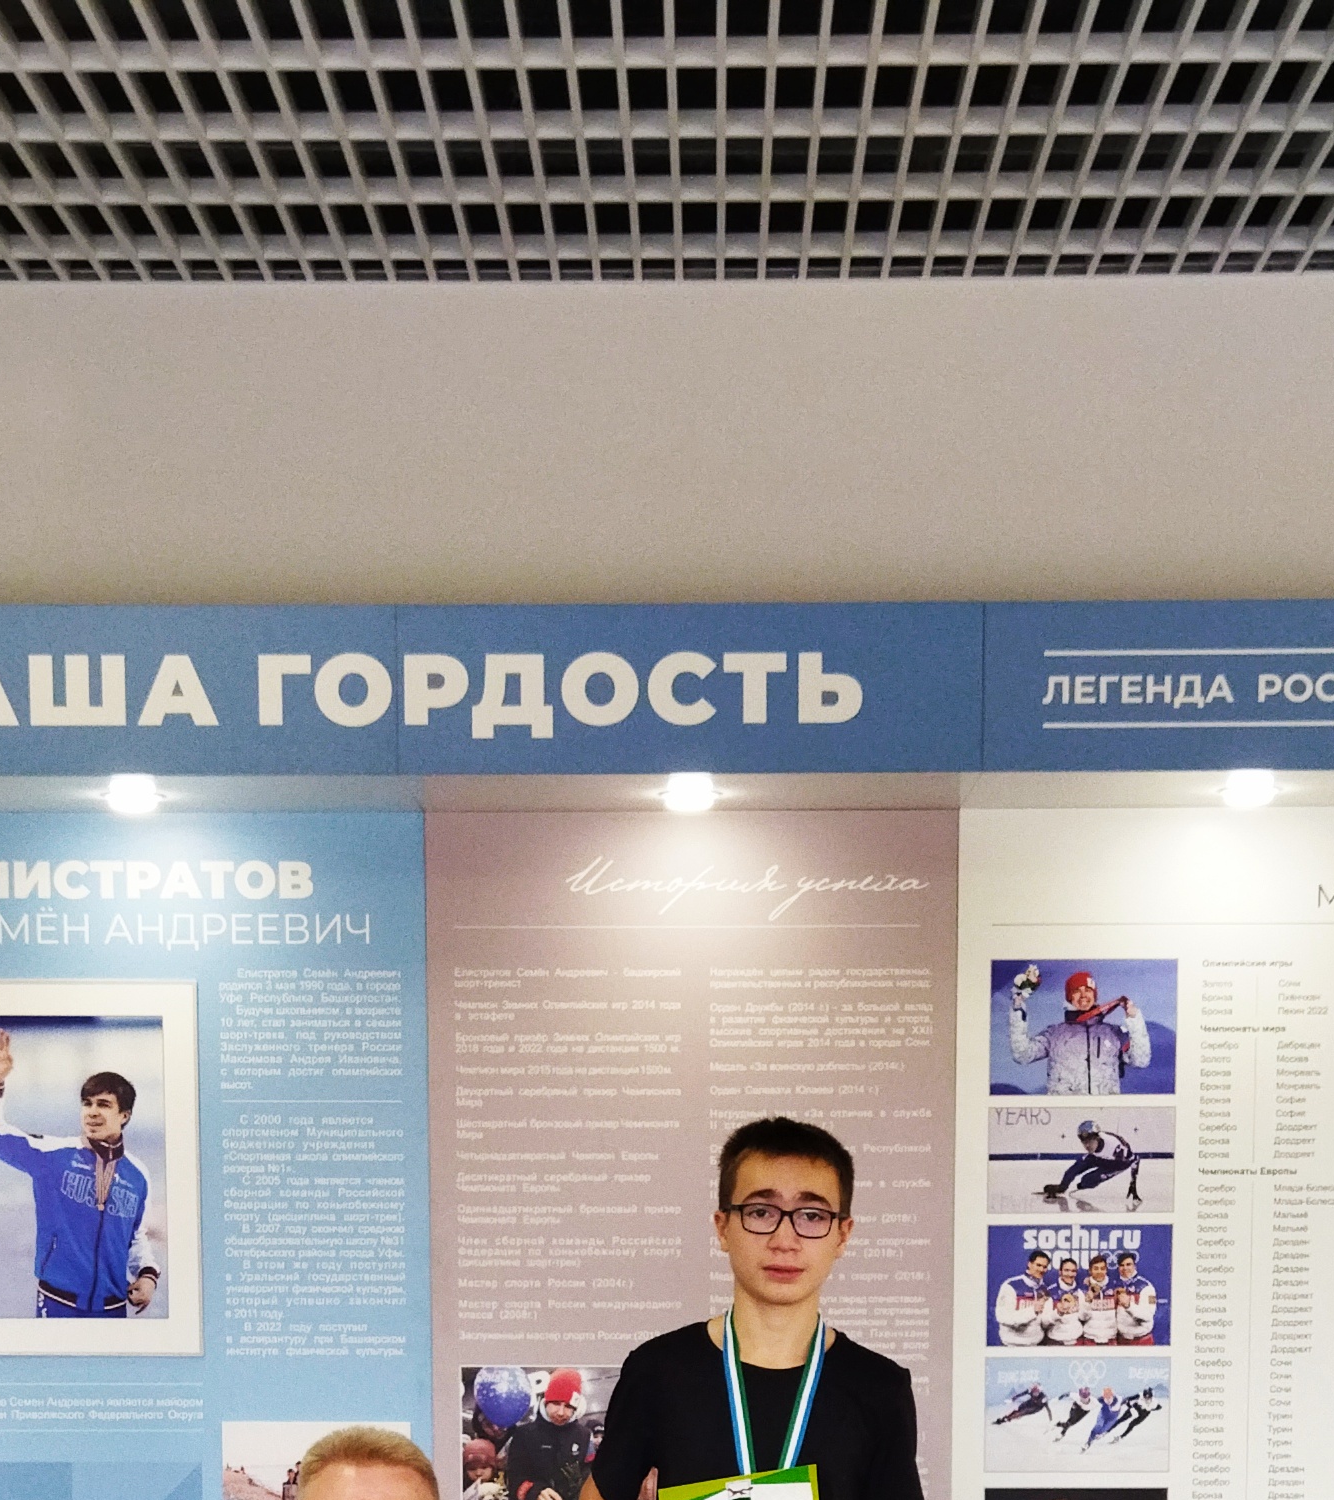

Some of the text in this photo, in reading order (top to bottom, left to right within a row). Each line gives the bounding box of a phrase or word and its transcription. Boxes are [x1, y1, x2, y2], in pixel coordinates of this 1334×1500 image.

[257, 649, 865, 741] ГОРДОСТЬ
[1041, 674, 1235, 712] ЛЕГЕНДА
[566, 855, 929, 921] История успеха
[104, 913, 370, 951] АНДРЕЕВИЧ
[300, 981, 323, 990] 1990
[221, 1018, 233, 1027] 10
[254, 1115, 281, 1124] 2000
[1198, 1167, 1297, 1176] Чемпионаты Европы
[1023, 1225, 1141, 1250] sochi.ru
